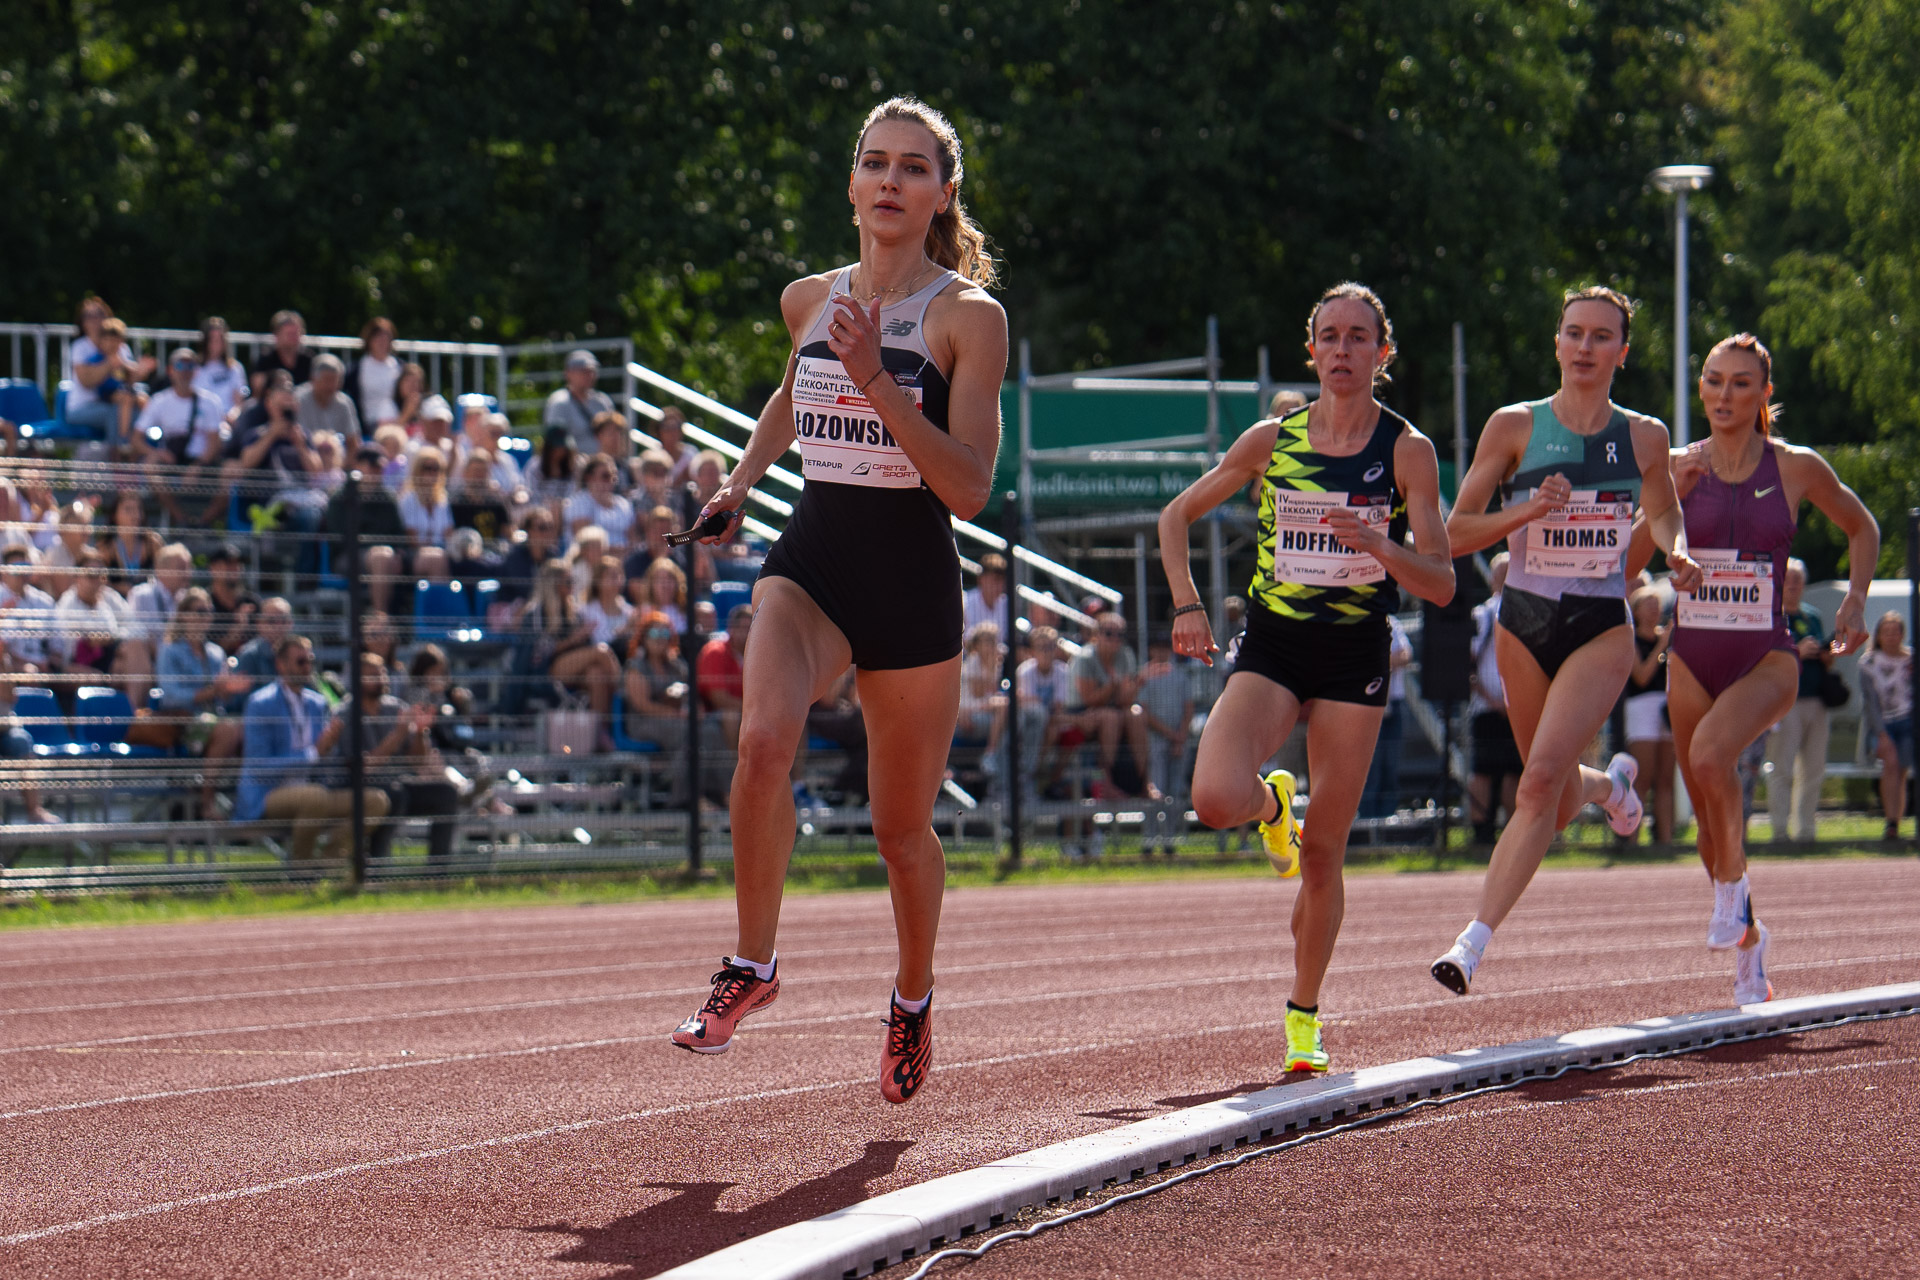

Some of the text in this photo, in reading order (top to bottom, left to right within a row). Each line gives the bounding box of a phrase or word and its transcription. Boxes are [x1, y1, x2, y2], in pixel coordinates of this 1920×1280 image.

[799, 364, 811, 376] IV
[804, 459, 843, 470] TETRAPUR
[1279, 494, 1289, 504] IV
[1543, 528, 1618, 548] THOMAS
